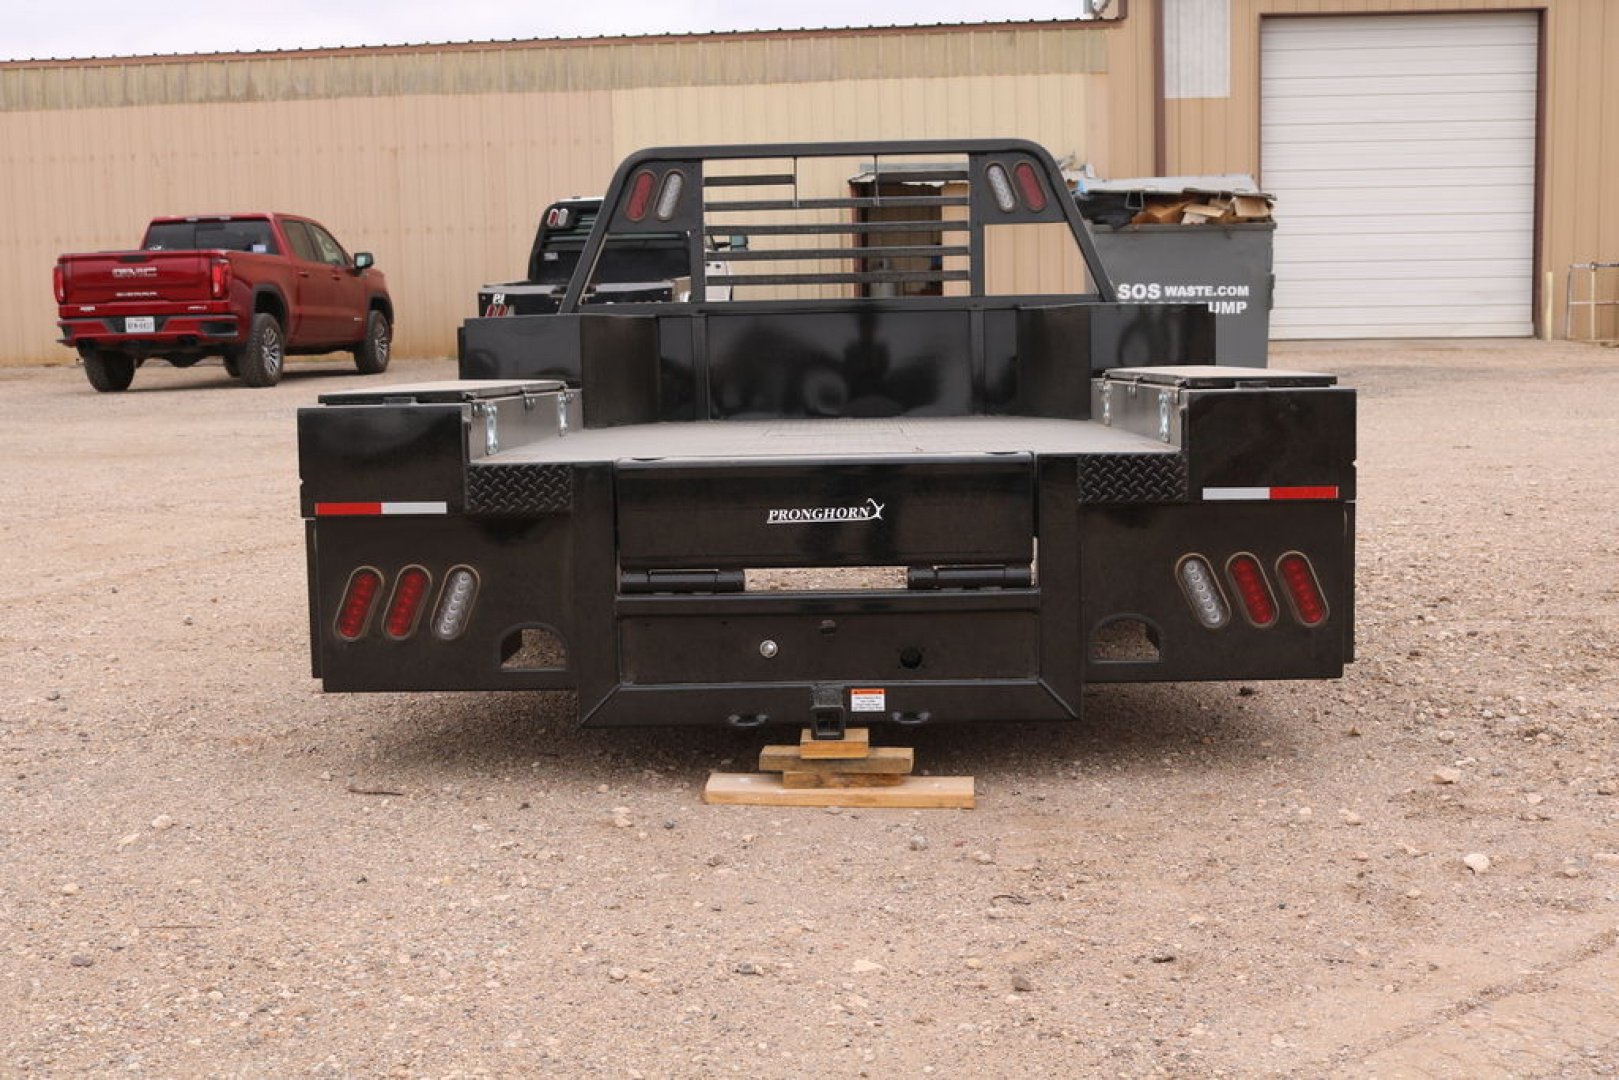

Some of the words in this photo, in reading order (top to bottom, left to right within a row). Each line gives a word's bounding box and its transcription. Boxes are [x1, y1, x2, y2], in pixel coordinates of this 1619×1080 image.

[112, 267, 158, 278] GMC
[1117, 283, 1161, 299] SOS
[1164, 285, 1249, 297] WASTE.COM
[1199, 301, 1247, 314] UMP
[769, 507, 870, 521] PRONGHORN
